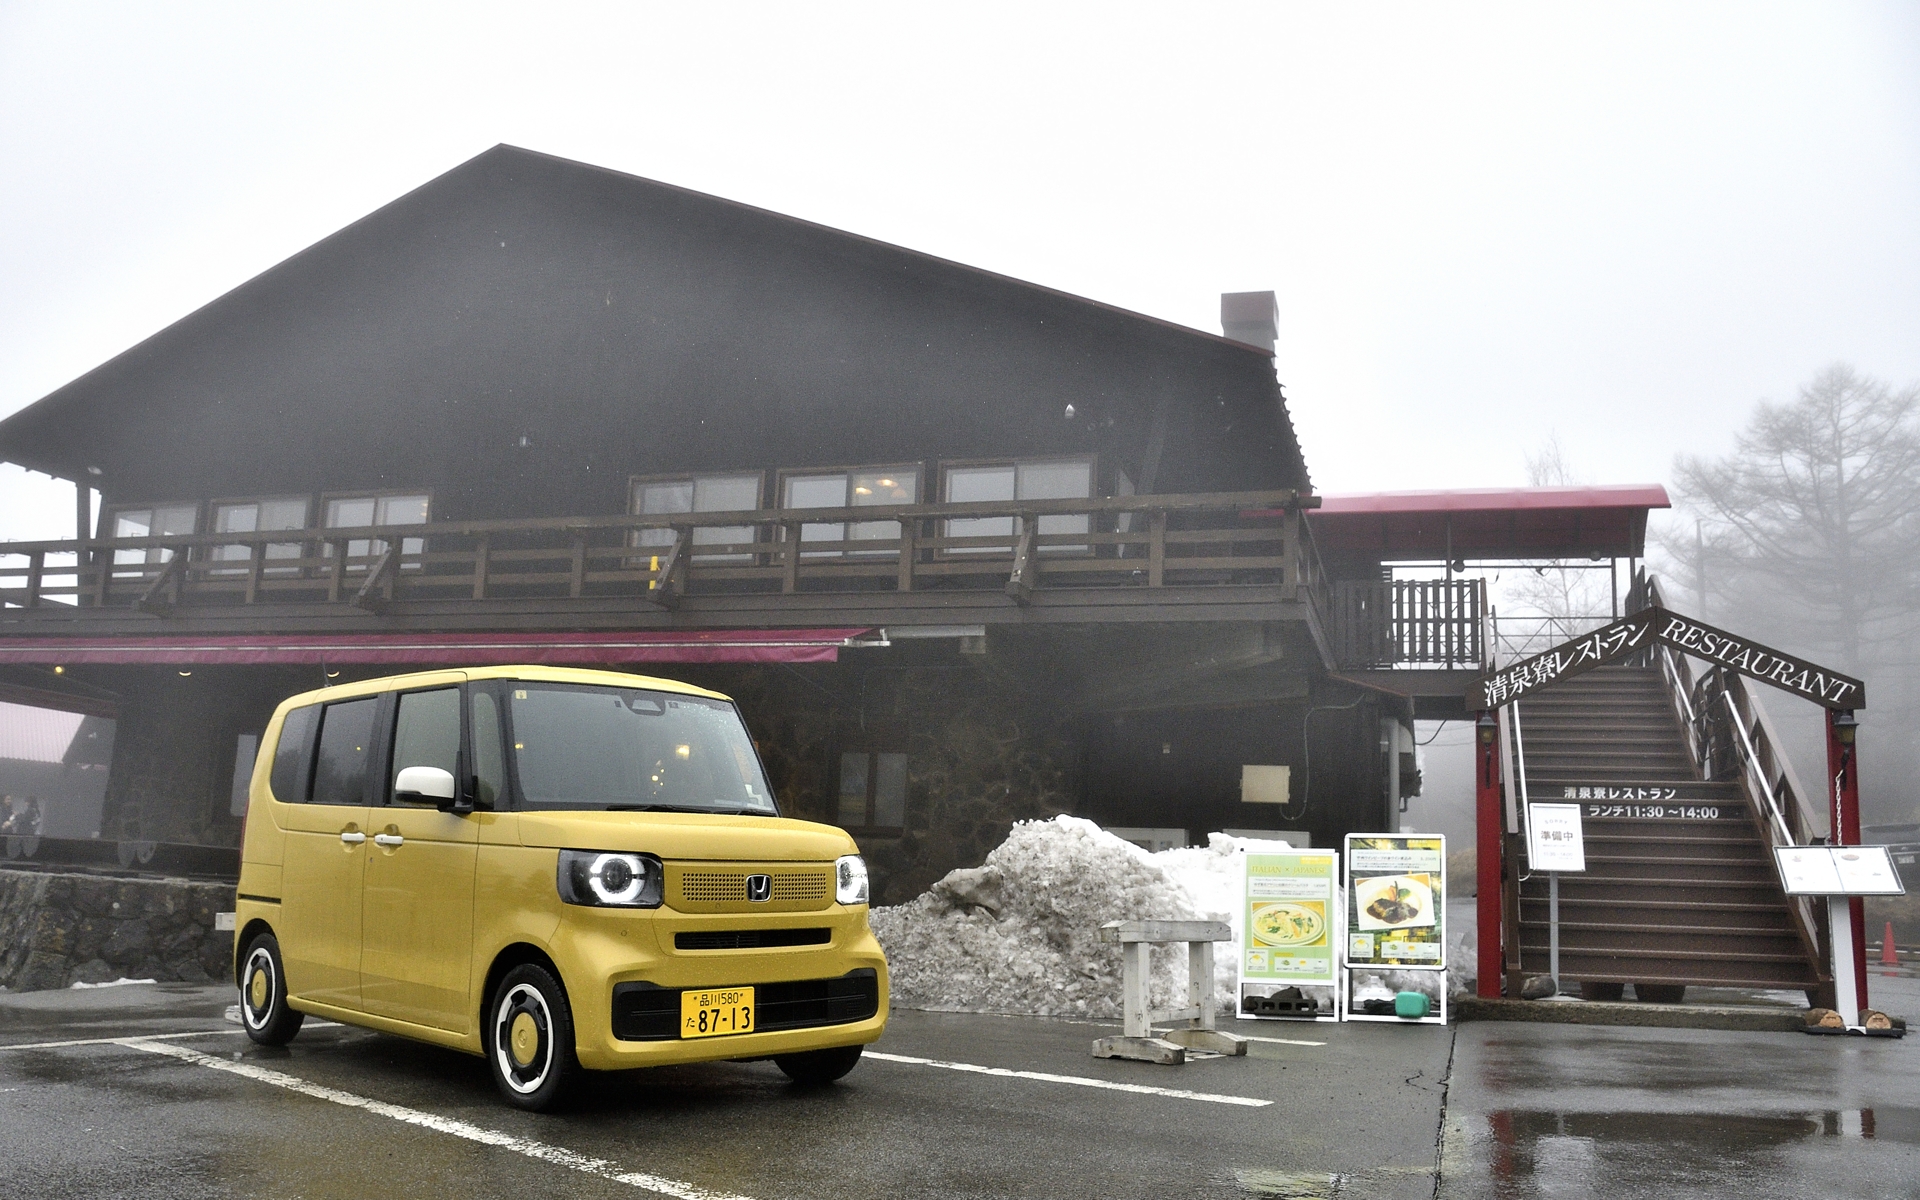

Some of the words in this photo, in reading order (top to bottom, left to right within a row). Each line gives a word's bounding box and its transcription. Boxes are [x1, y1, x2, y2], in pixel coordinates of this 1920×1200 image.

[1484, 622, 1650, 707] 清泉寮レストラン
[1659, 617, 1856, 703] RESTAURANT
[1564, 786, 1676, 800] 清泉寮レストラン
[1589, 804, 1664, 818] ランチ11:30
[1540, 830, 1573, 842] 準備中
[1292, 867, 1326, 875] JAPANESE
[700, 992, 739, 1007] 品川580
[686, 1017, 696, 1028] た
[698, 1006, 751, 1033] 87-13
